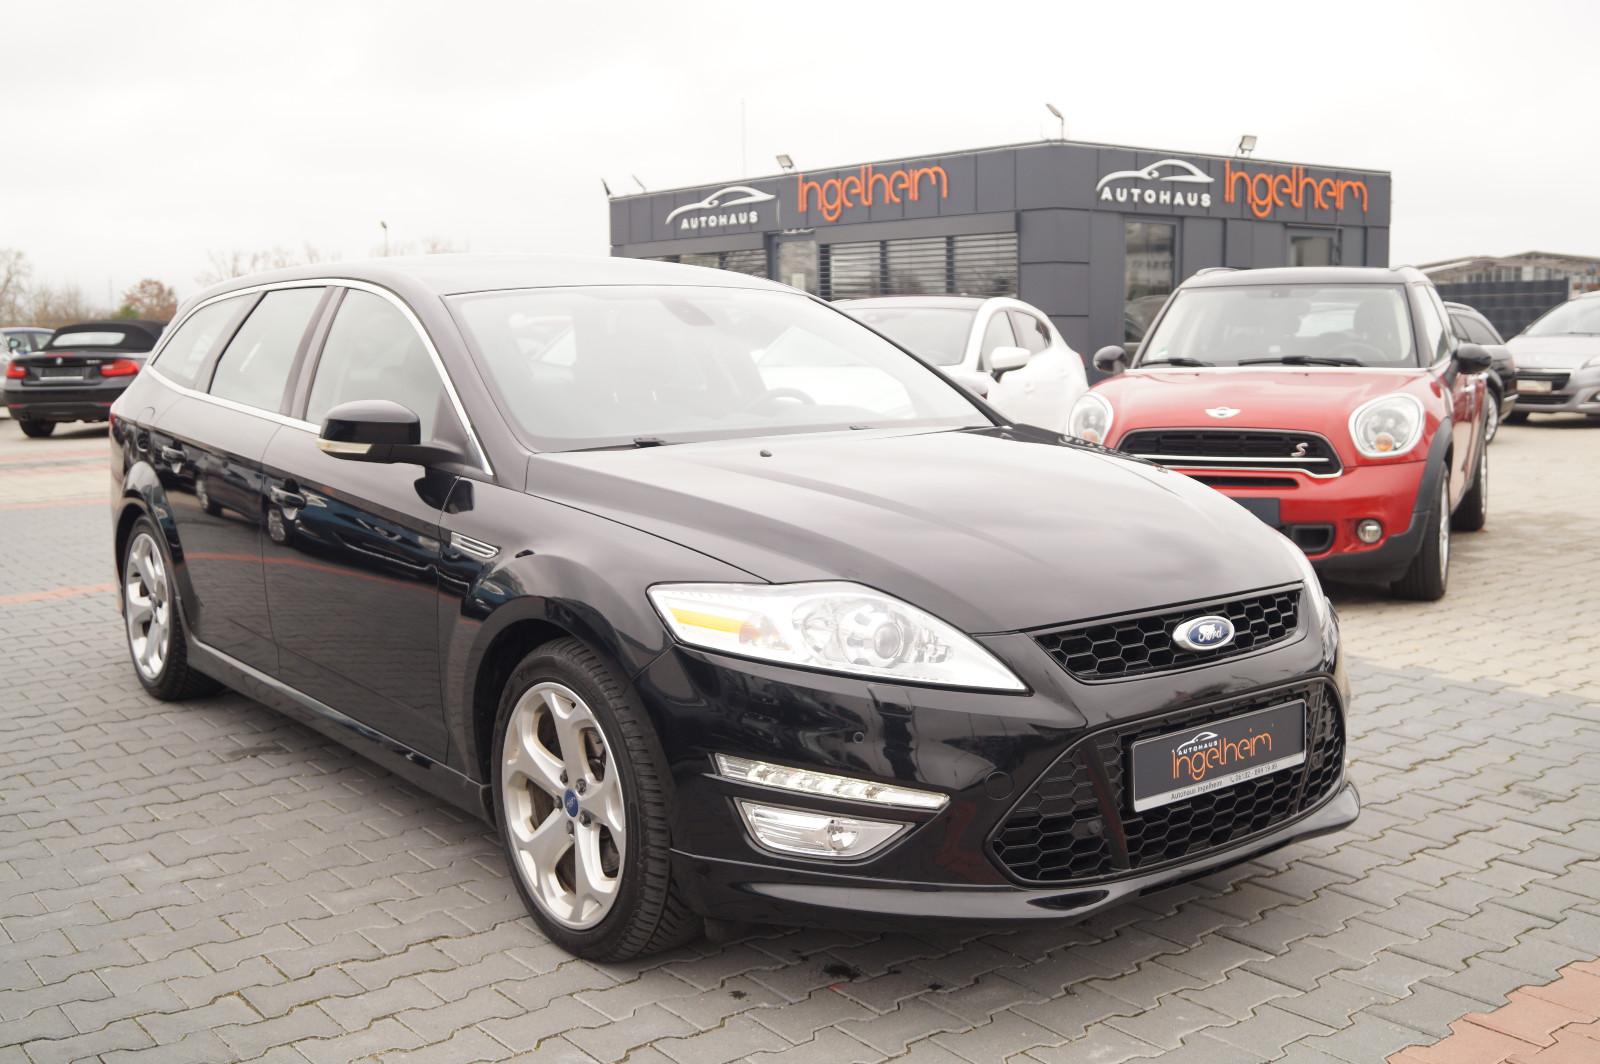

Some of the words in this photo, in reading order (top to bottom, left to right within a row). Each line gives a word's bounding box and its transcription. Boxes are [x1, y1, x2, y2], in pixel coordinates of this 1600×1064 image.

[680, 210, 759, 230] AUTOHAUS
[798, 163, 948, 222] Ingelheim
[1100, 186, 1212, 208] AUTOHAUS
[1224, 159, 1369, 218] Ingelheim
[1198, 623, 1222, 642] Ford
[1171, 727, 1272, 780] Ingelheim
[1178, 740, 1218, 756] AUTOHAUS
